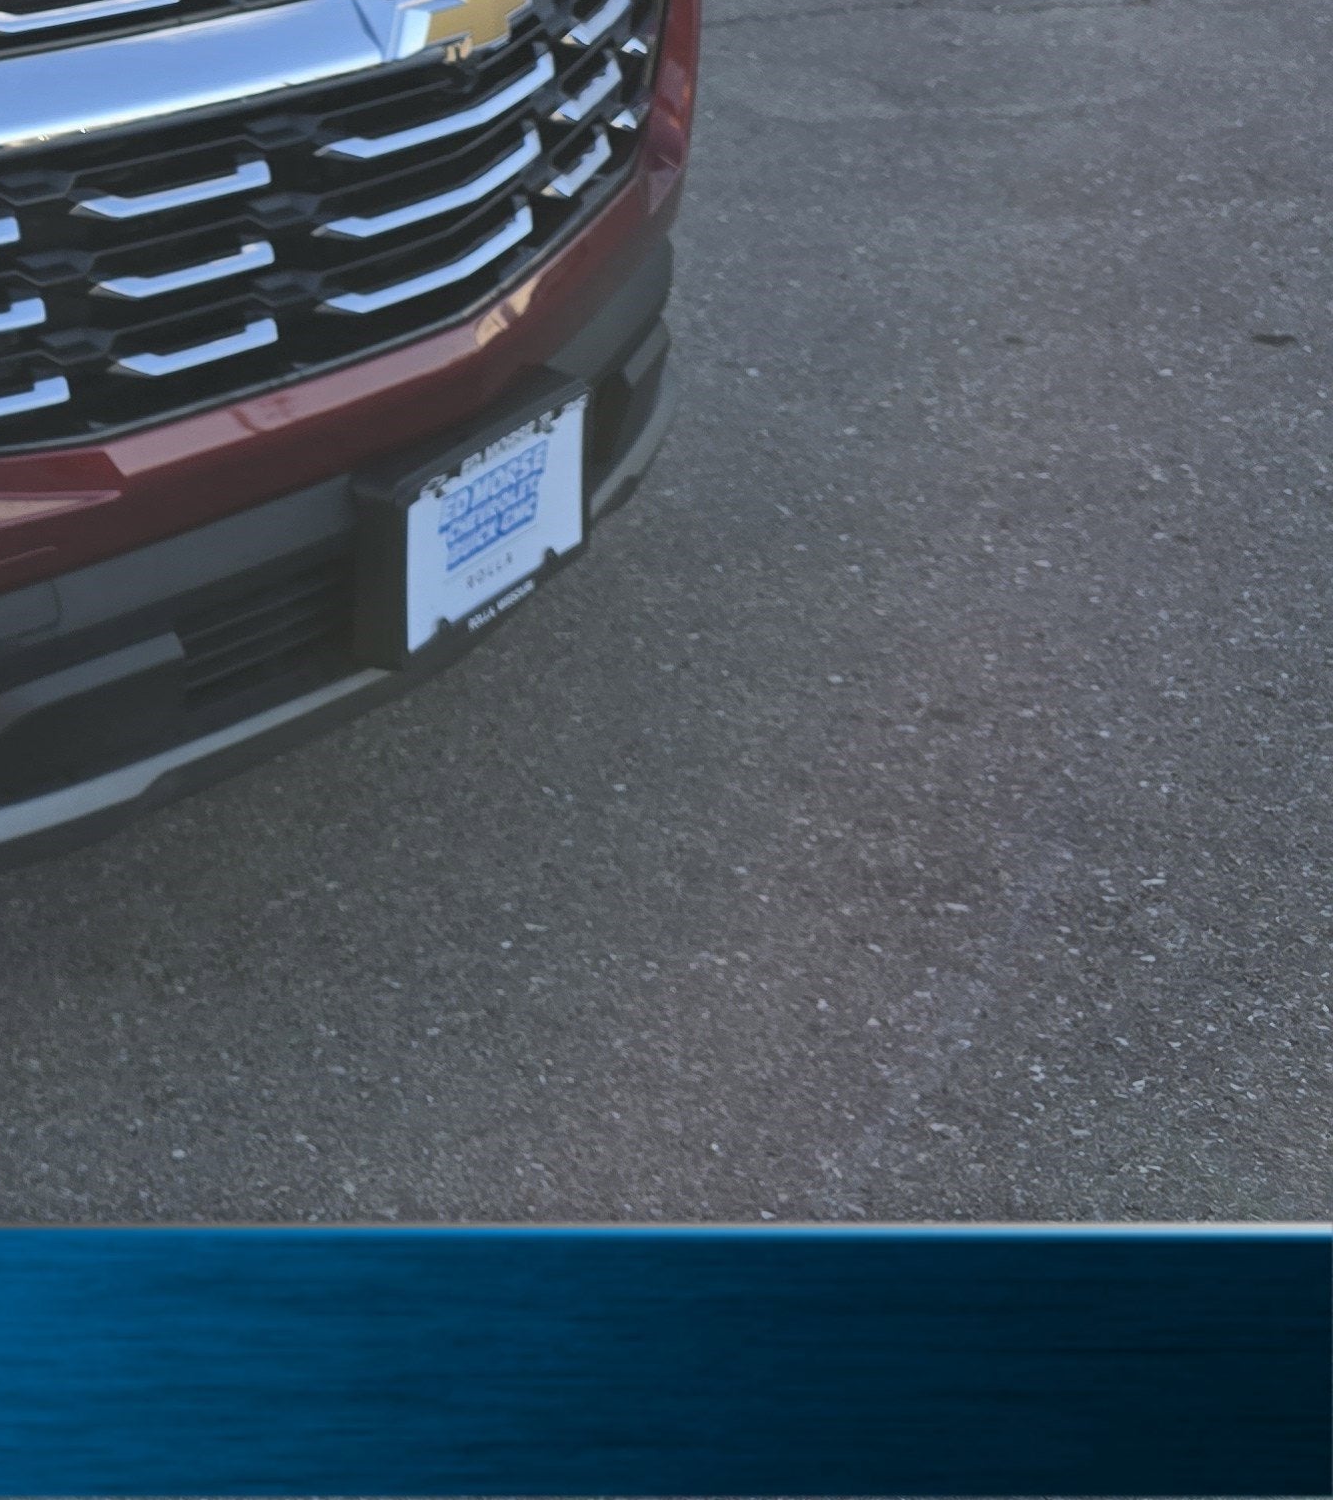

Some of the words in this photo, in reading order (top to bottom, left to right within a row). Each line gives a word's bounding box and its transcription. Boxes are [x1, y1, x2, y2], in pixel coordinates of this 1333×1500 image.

[440, 485, 469, 531] ED
[470, 438, 548, 513] MORSE
[467, 547, 513, 590] ROLLA
